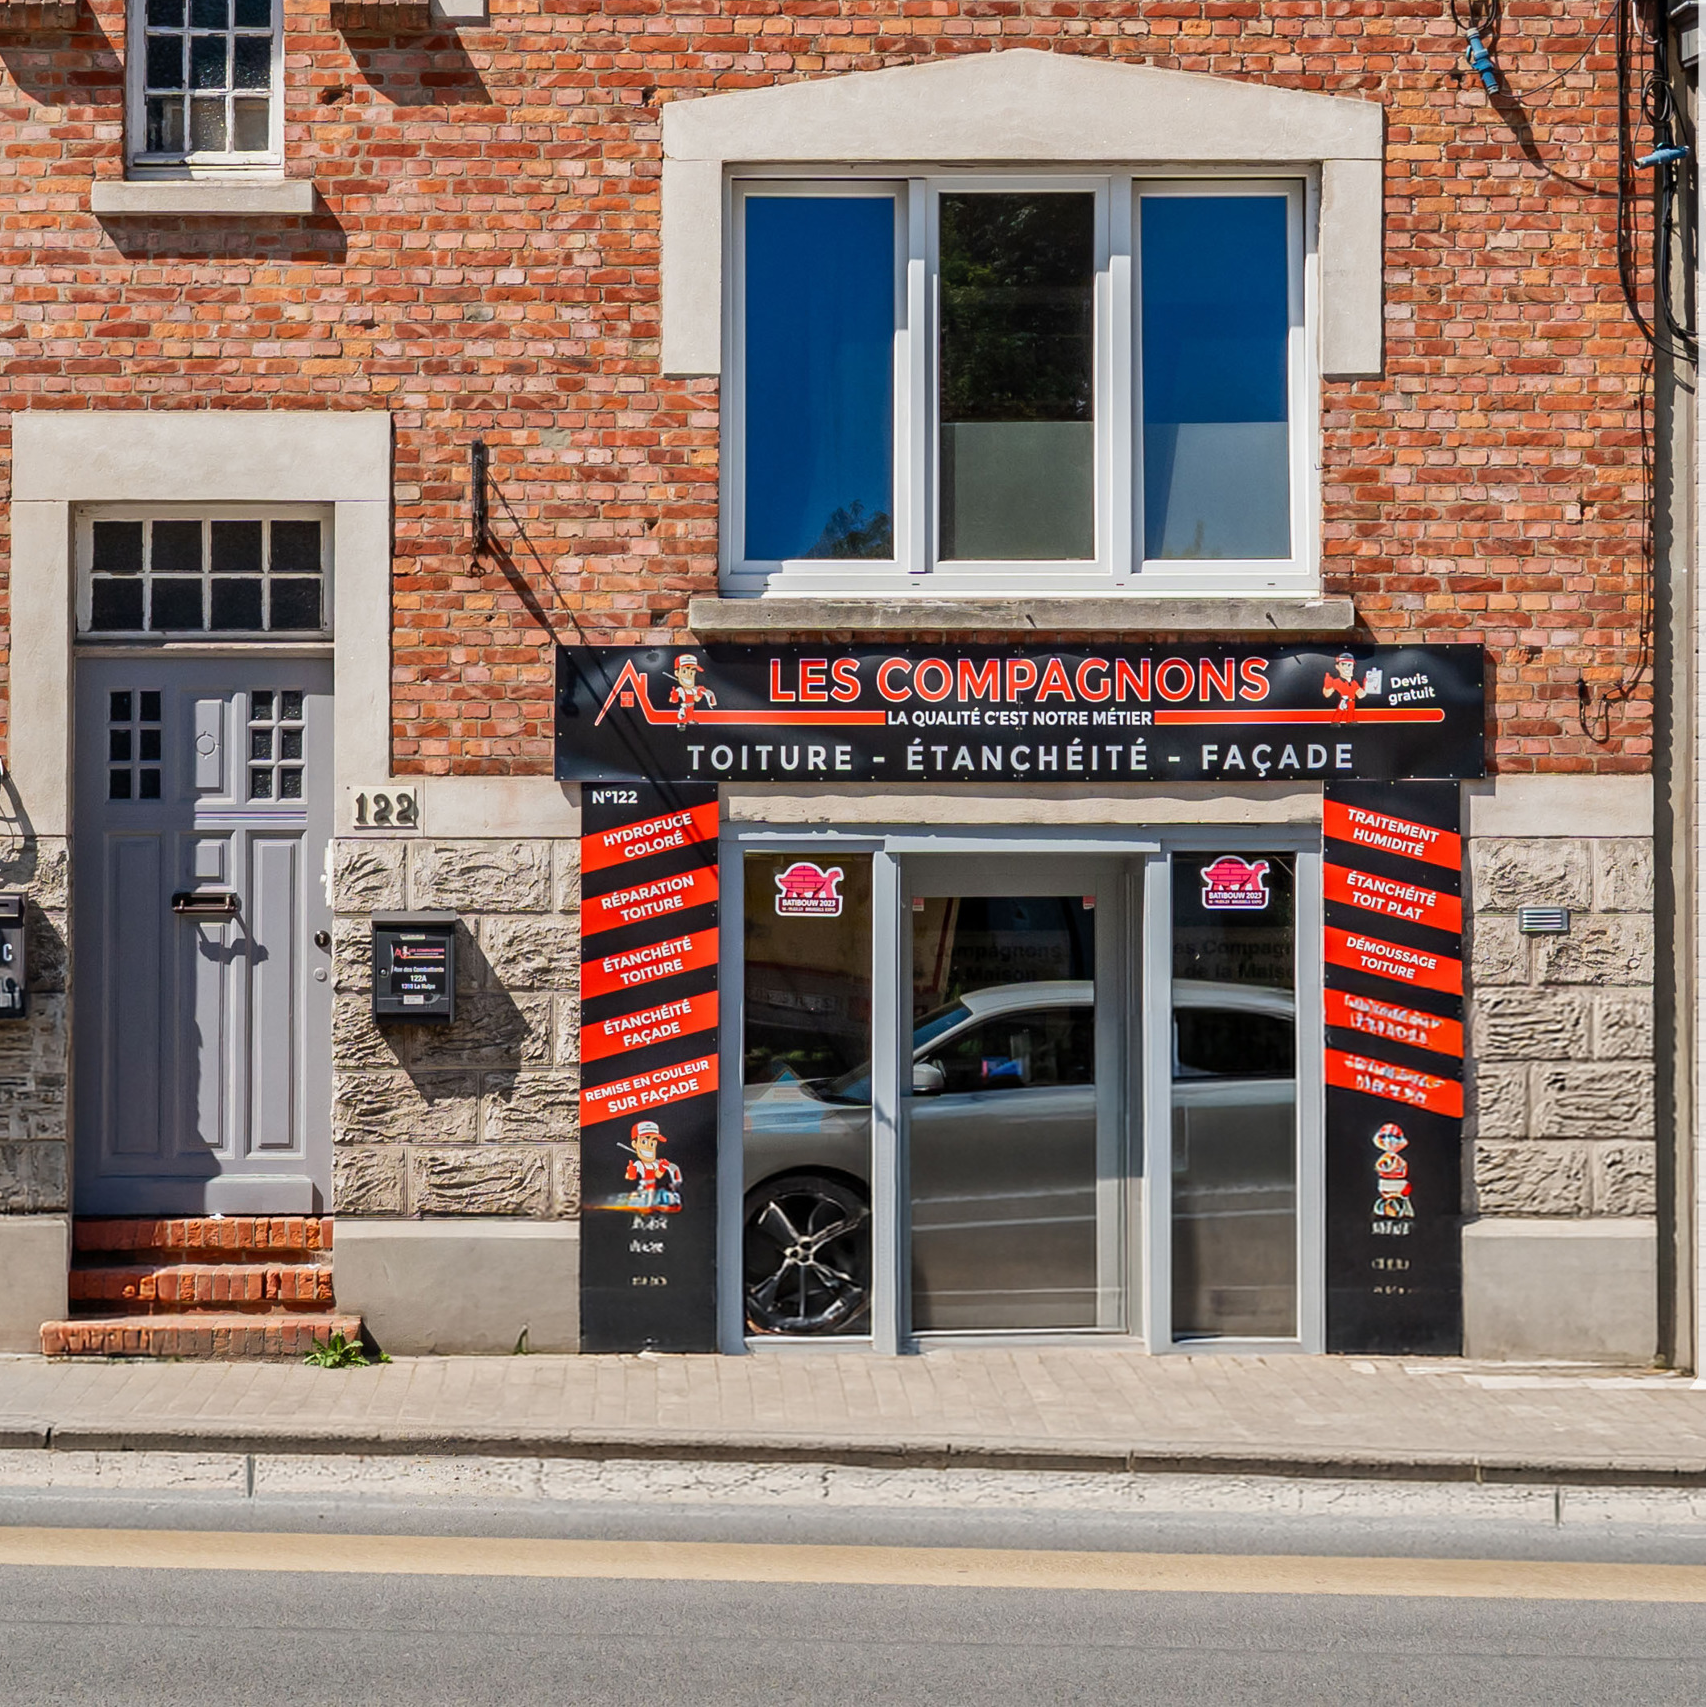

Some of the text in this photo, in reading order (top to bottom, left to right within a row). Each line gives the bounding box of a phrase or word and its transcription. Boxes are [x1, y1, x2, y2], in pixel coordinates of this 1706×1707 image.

[769, 656, 1271, 703] LES COMPAGNONS
[1390, 673, 1429, 688] Devis
[1388, 686, 1436, 706] gratuit
[888, 711, 909, 726] LA
[912, 706, 981, 727] QUALITÉ
[1033, 710, 1088, 725] NOTRE
[1093, 706, 1152, 725] MÉTIER
[687, 745, 853, 771] TOITURE
[906, 737, 1148, 771] ÉTANCHÉITÉ
[1201, 744, 1353, 777] FAÇADE
[355, 793, 414, 825] 122
[592, 790, 638, 804] N°122
[603, 812, 693, 847] HYDROFUGE
[1348, 808, 1440, 843] TRAITEMENT
[624, 830, 684, 858] COLORÉ
[1353, 827, 1425, 857] HUMIDITÉ
[601, 874, 694, 910] RÉPARATION
[781, 898, 836, 906] BATIBOUW 2023
[1208, 891, 1263, 899] BATIBOUW 2023
[1346, 871, 1437, 907] ÉTANCHÉITÉ
[620, 895, 684, 921] TOITURE
[1352, 891, 1424, 920] TOIT PLAT
[602, 936, 693, 973] ÉTANCHÉITÉ
[1346, 936, 1437, 970] DÉMOUSSAGE
[1360, 955, 1416, 979] TOITURE
[410, 974, 427, 982] 122A
[620, 959, 683, 985] TOITURE
[603, 999, 692, 1036] ÉTANCHÉITÉ
[622, 1021, 681, 1047] FAÇADE
[585, 1059, 710, 1102] REMISE EN COULEUR
[608, 1078, 700, 1113] SUR FAÇADE
